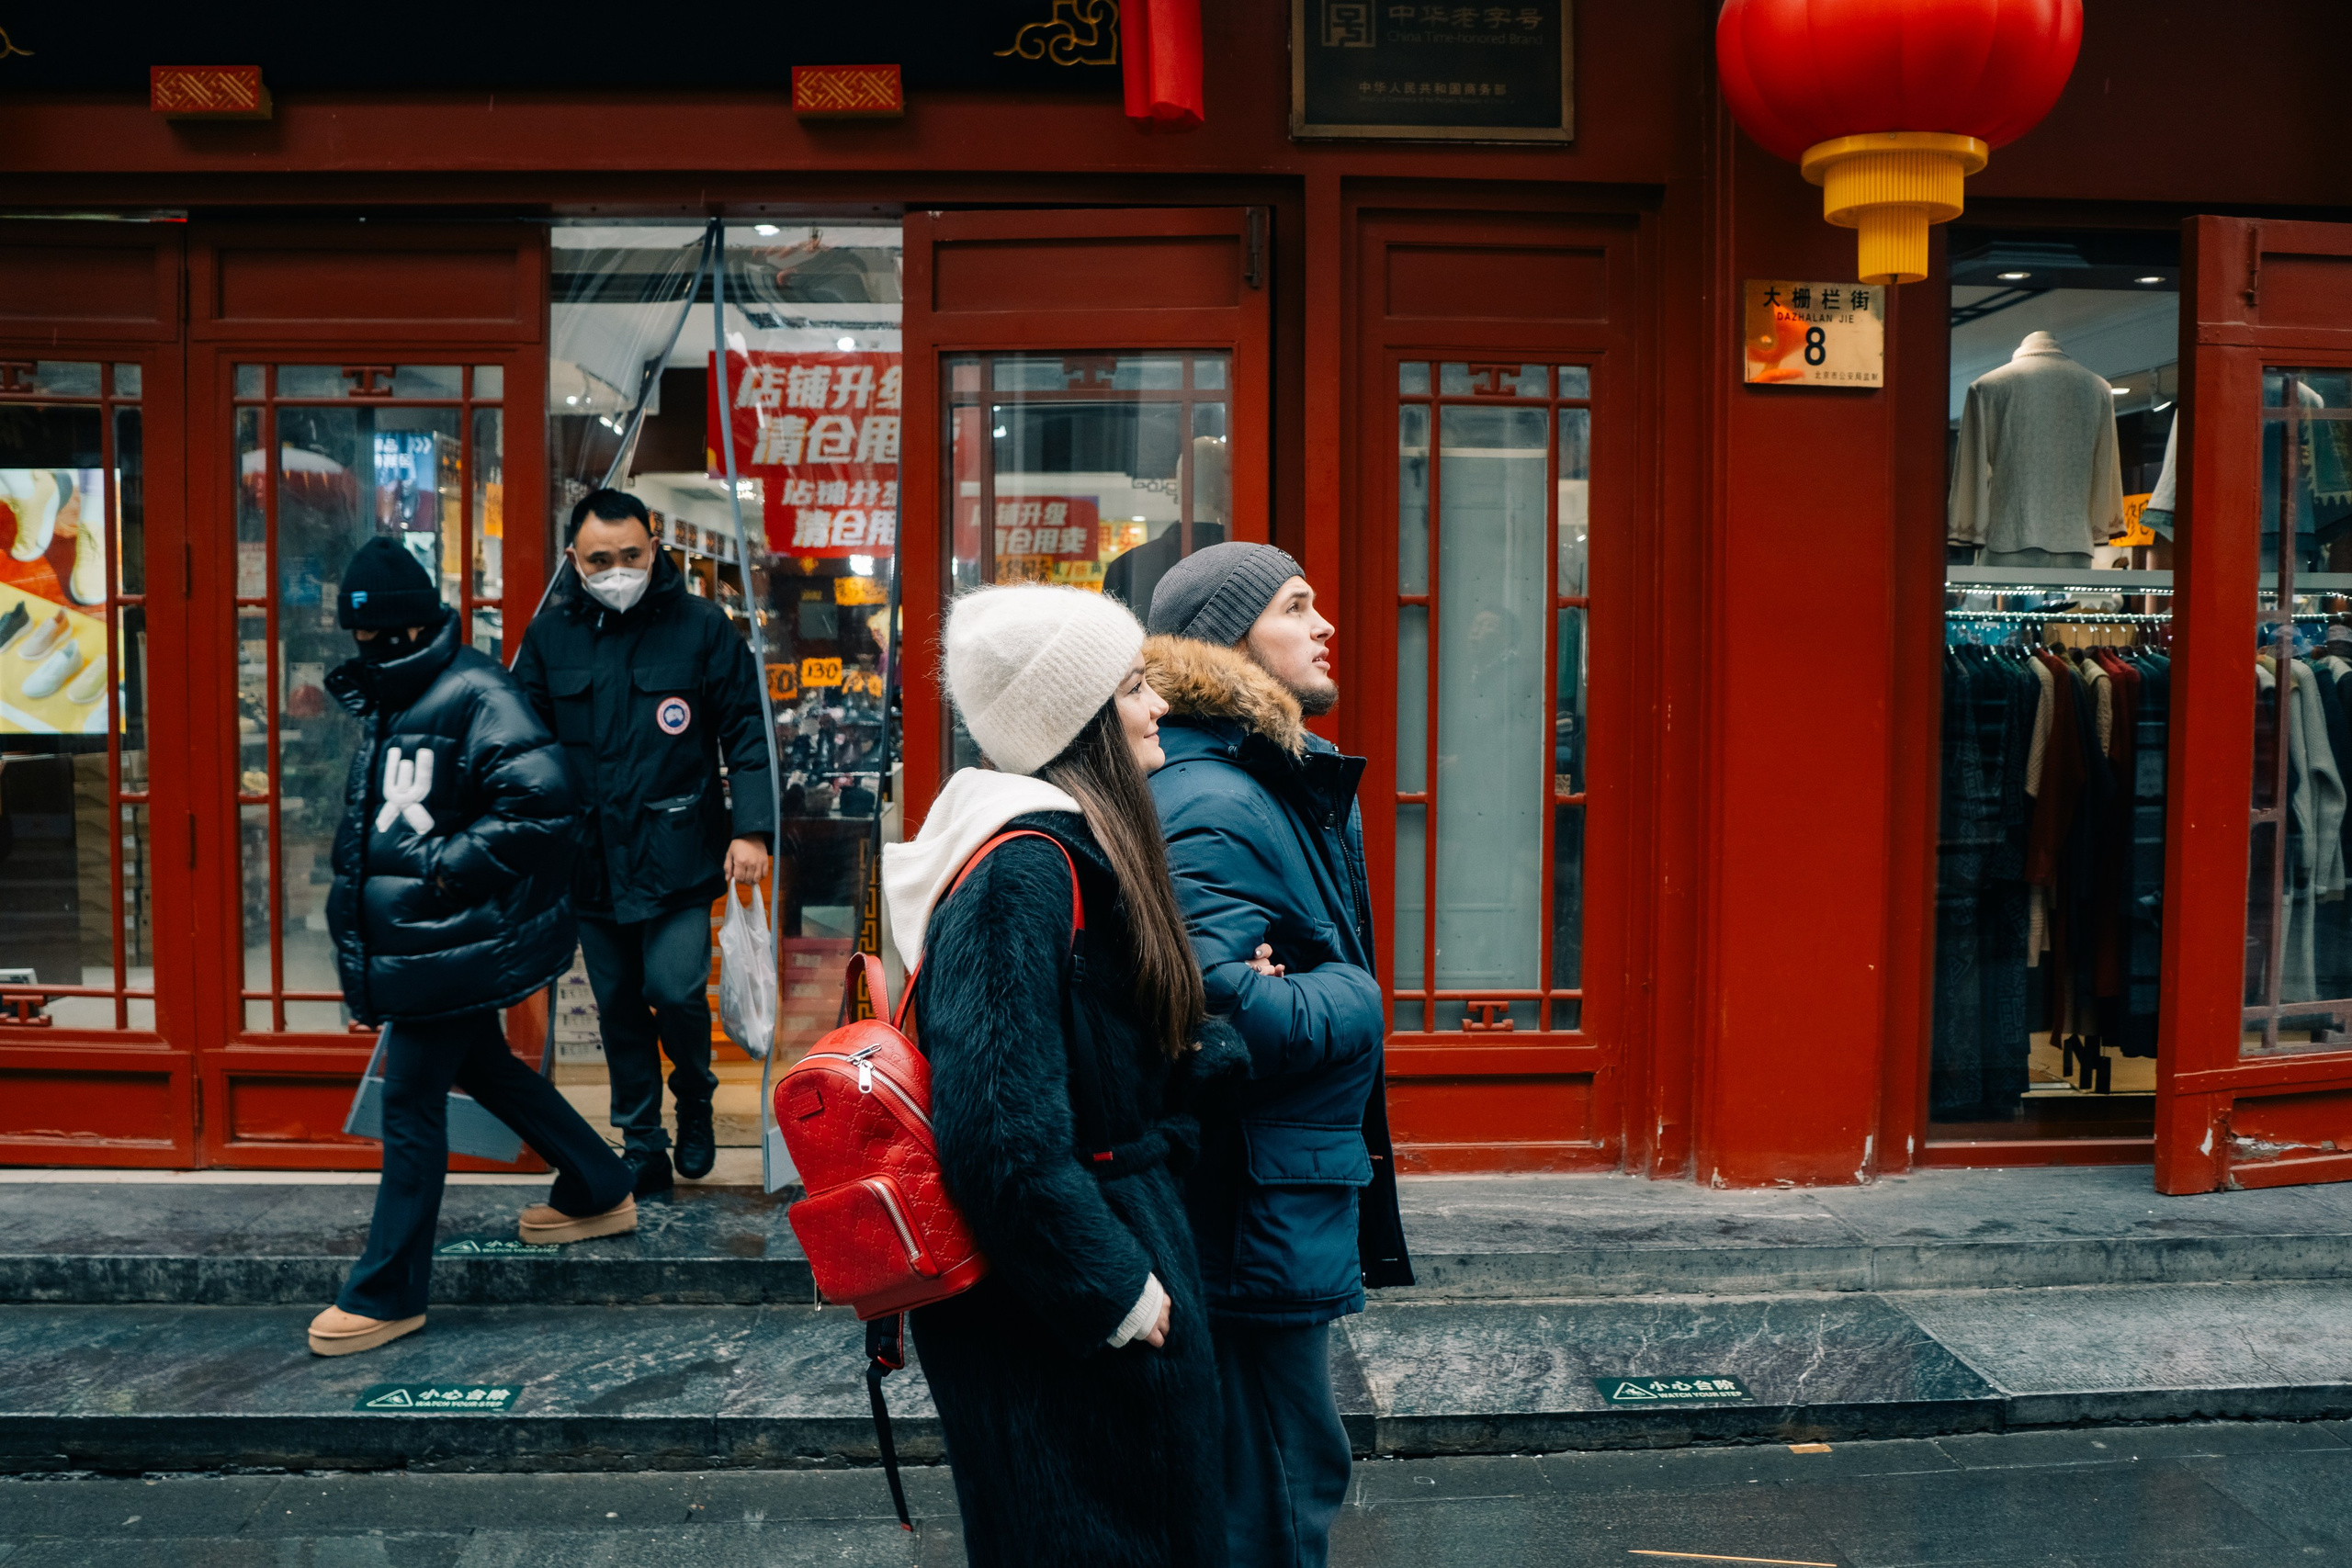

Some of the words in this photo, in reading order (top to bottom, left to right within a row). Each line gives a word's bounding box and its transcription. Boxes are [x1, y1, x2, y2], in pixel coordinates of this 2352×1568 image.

[1388, 5, 1544, 29] 中华老字号
[1387, 31, 1421, 43] China
[1424, 31, 1506, 44] Time-honored
[1510, 33, 1544, 45] Brand
[1359, 81, 1507, 96] 中华人民共和国商务部
[1763, 287, 1870, 310] 大栅栏街
[1777, 311, 1833, 322] DAZHALAN
[1839, 314, 1854, 323] JIE
[1804, 326, 1826, 366] 8
[807, 662, 838, 680] 130
[1649, 1379, 1736, 1392] 小心台阶
